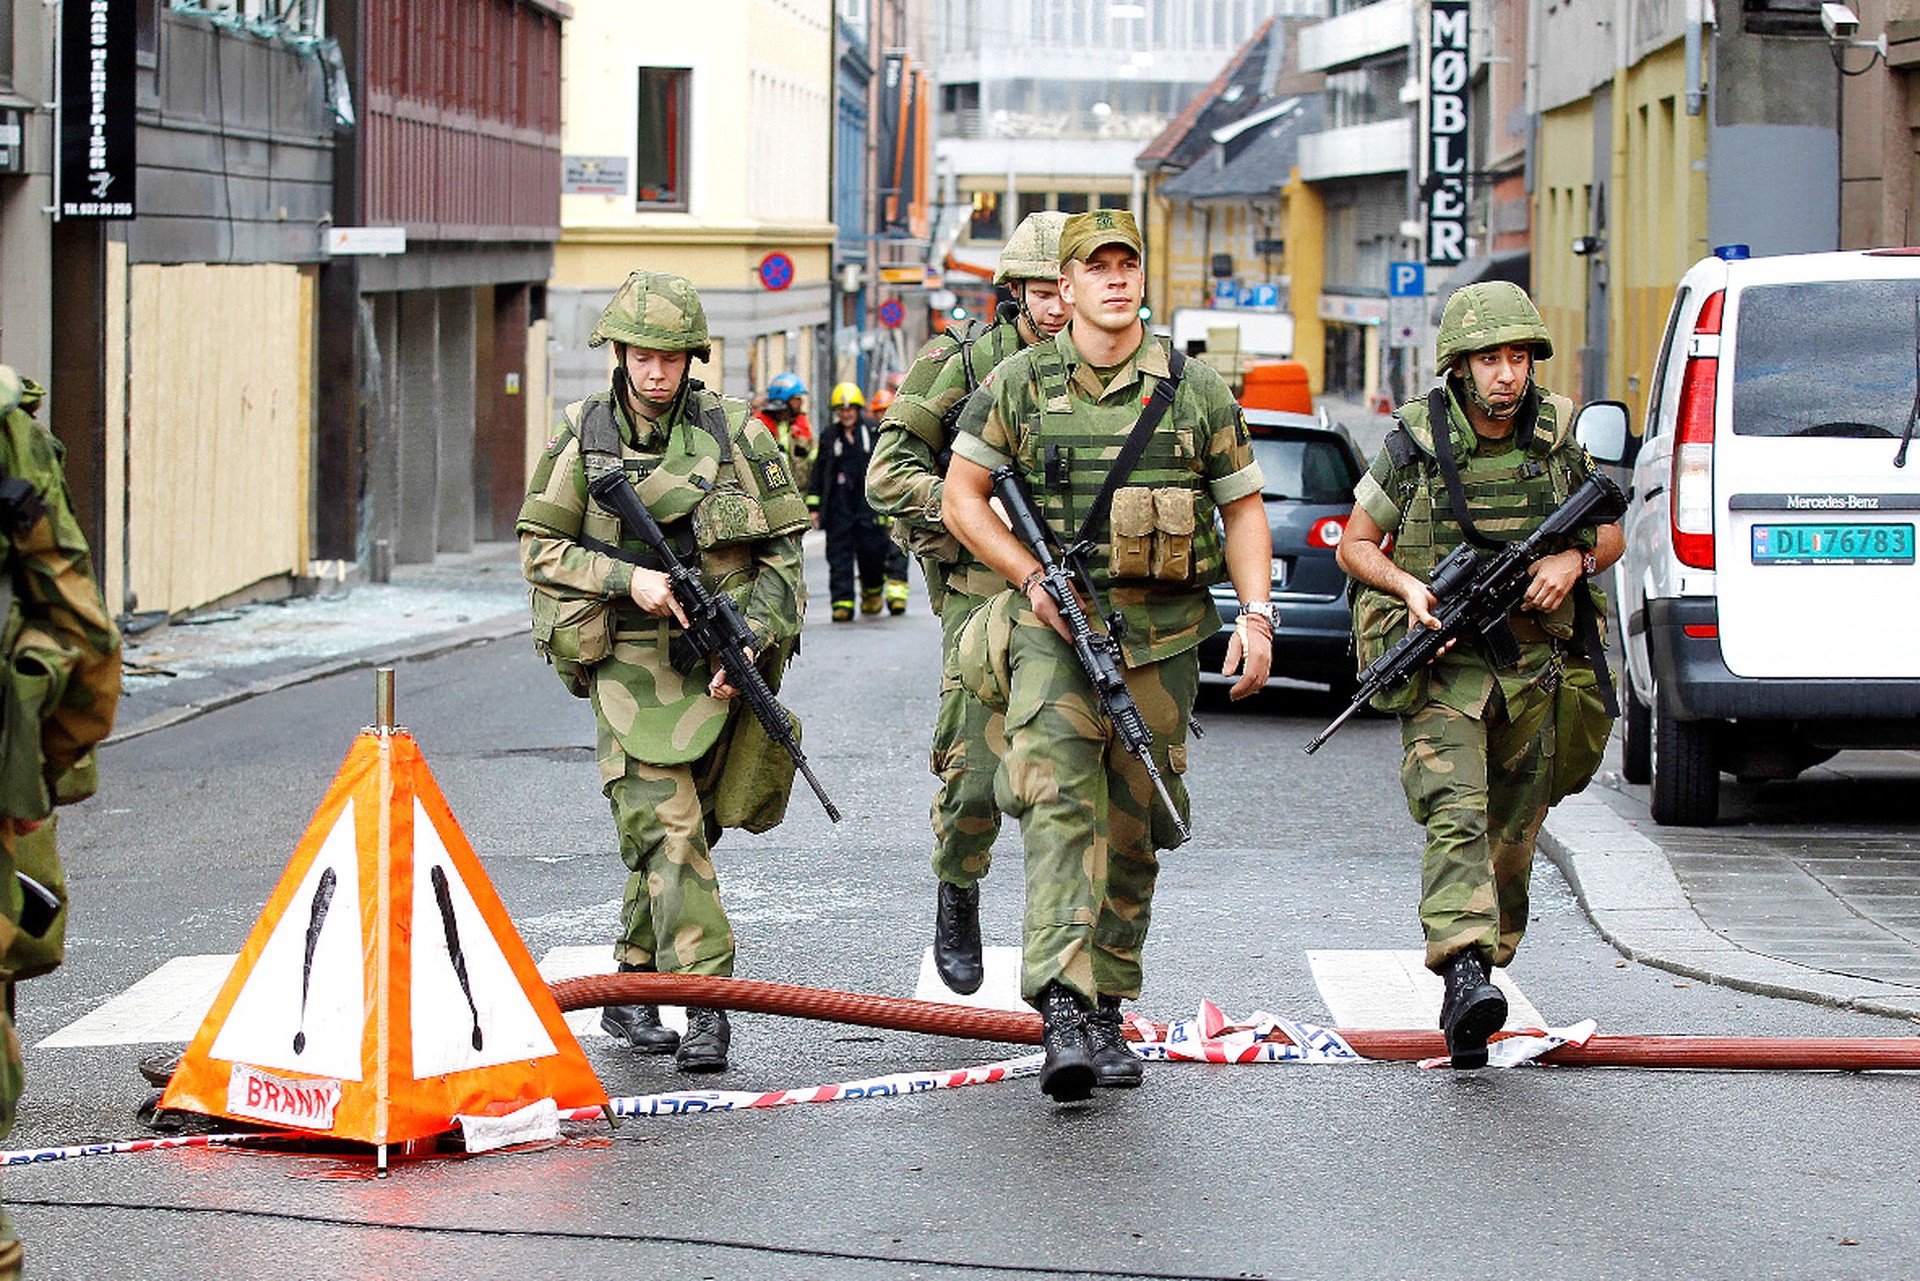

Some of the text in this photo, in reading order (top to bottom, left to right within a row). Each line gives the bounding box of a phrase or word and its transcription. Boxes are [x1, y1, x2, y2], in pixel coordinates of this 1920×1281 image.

[1430, 9, 1468, 260] MØBLER
[1397, 266, 1417, 293] P
[1787, 495, 1879, 509] Mercedes-Benz
[1777, 529, 1906, 554] DL 76783
[246, 1076, 331, 1119] BRANN
[617, 1098, 734, 1118] OLITI
[9, 1144, 116, 1164] POITI
